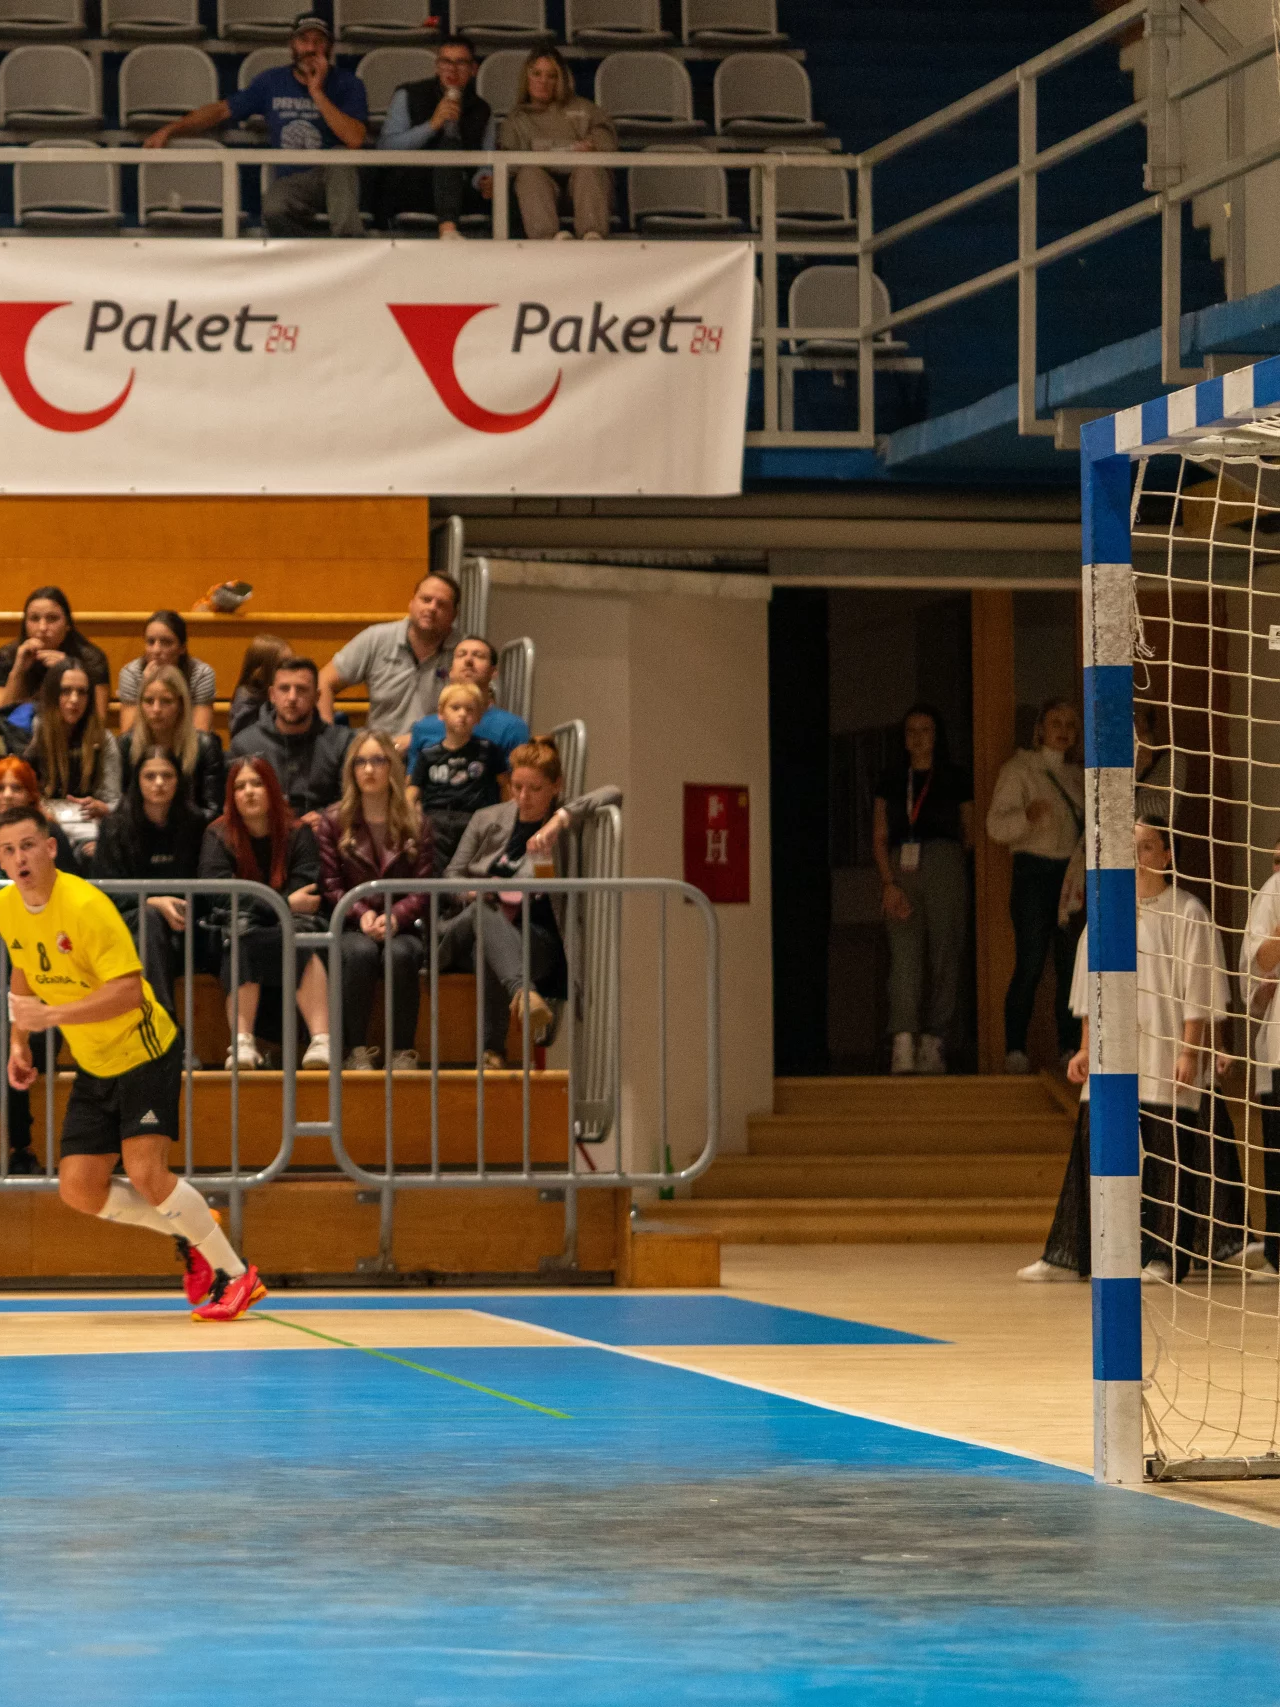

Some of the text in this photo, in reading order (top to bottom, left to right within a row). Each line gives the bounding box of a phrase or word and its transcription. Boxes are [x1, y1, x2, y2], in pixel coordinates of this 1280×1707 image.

[84, 299, 300, 353] Paket 24
[511, 301, 723, 354] Paket 24
[704, 828, 729, 864] H
[36, 941, 52, 972] 8
